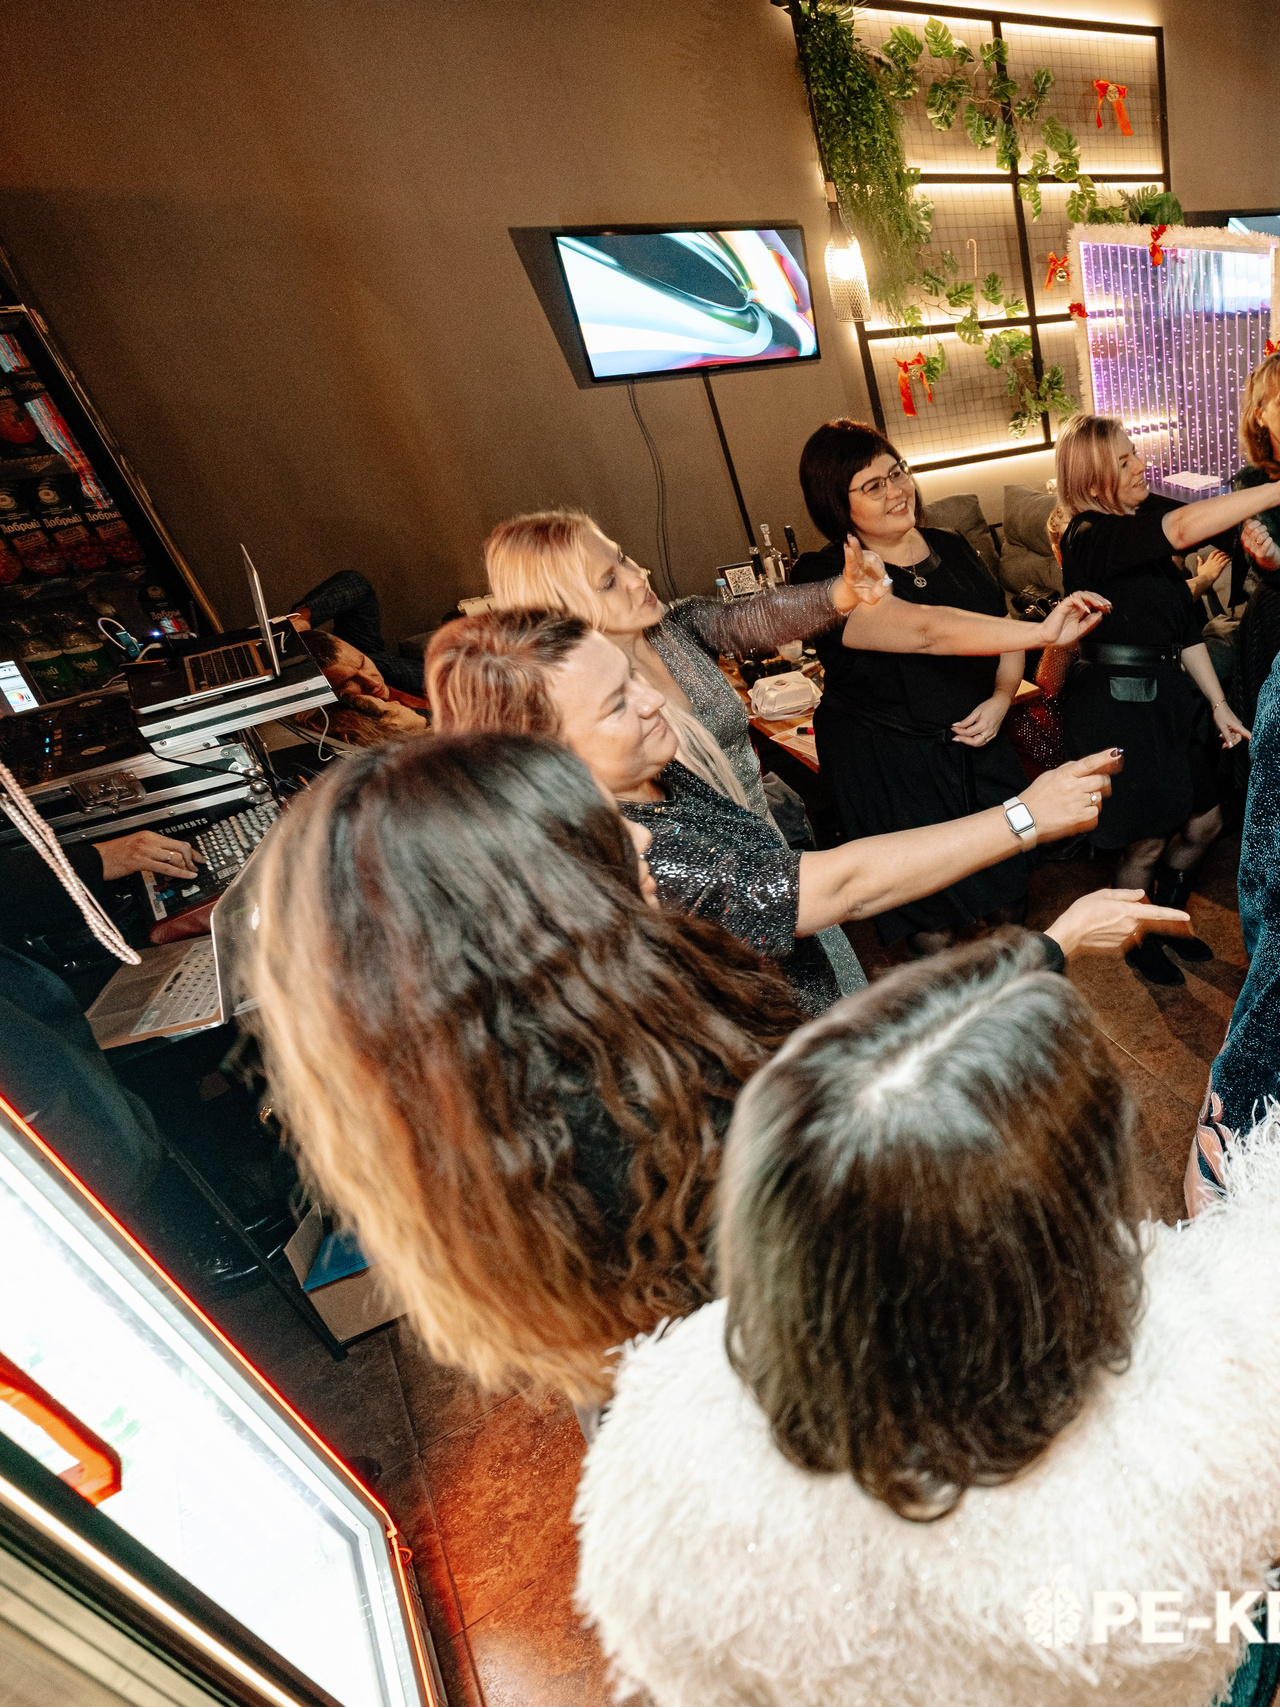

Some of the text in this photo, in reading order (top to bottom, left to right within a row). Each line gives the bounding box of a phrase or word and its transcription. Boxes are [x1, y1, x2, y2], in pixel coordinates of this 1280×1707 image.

[1, 518, 42, 534] Добрый
[43, 514, 83, 529] Добрый
[158, 817, 209, 835] TRUMENTS
